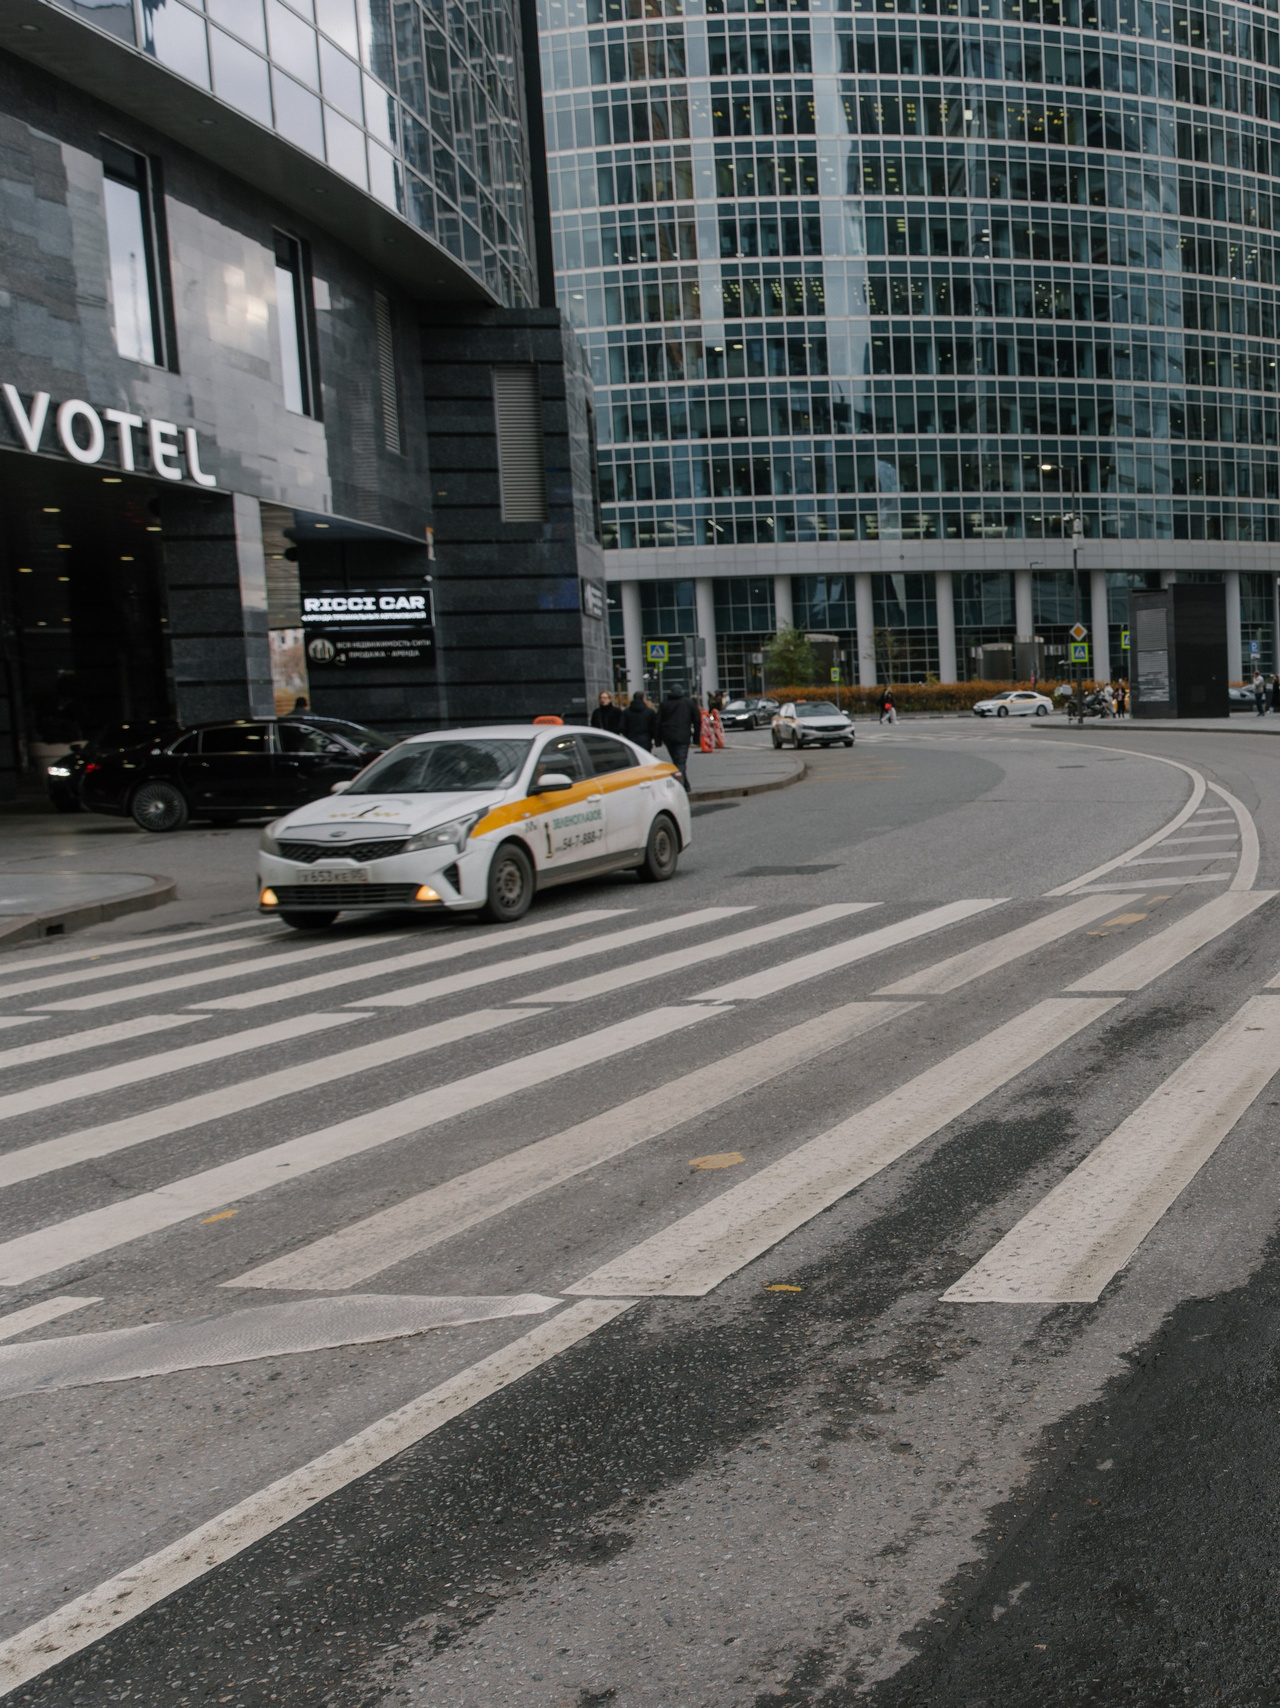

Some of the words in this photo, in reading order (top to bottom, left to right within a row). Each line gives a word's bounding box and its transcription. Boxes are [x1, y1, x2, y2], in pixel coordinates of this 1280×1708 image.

[2, 383, 217, 487] VOTEL
[304, 597, 377, 612] RICCI
[379, 595, 425, 610] CAR
[349, 651, 386, 659] ПРОДАЖА
